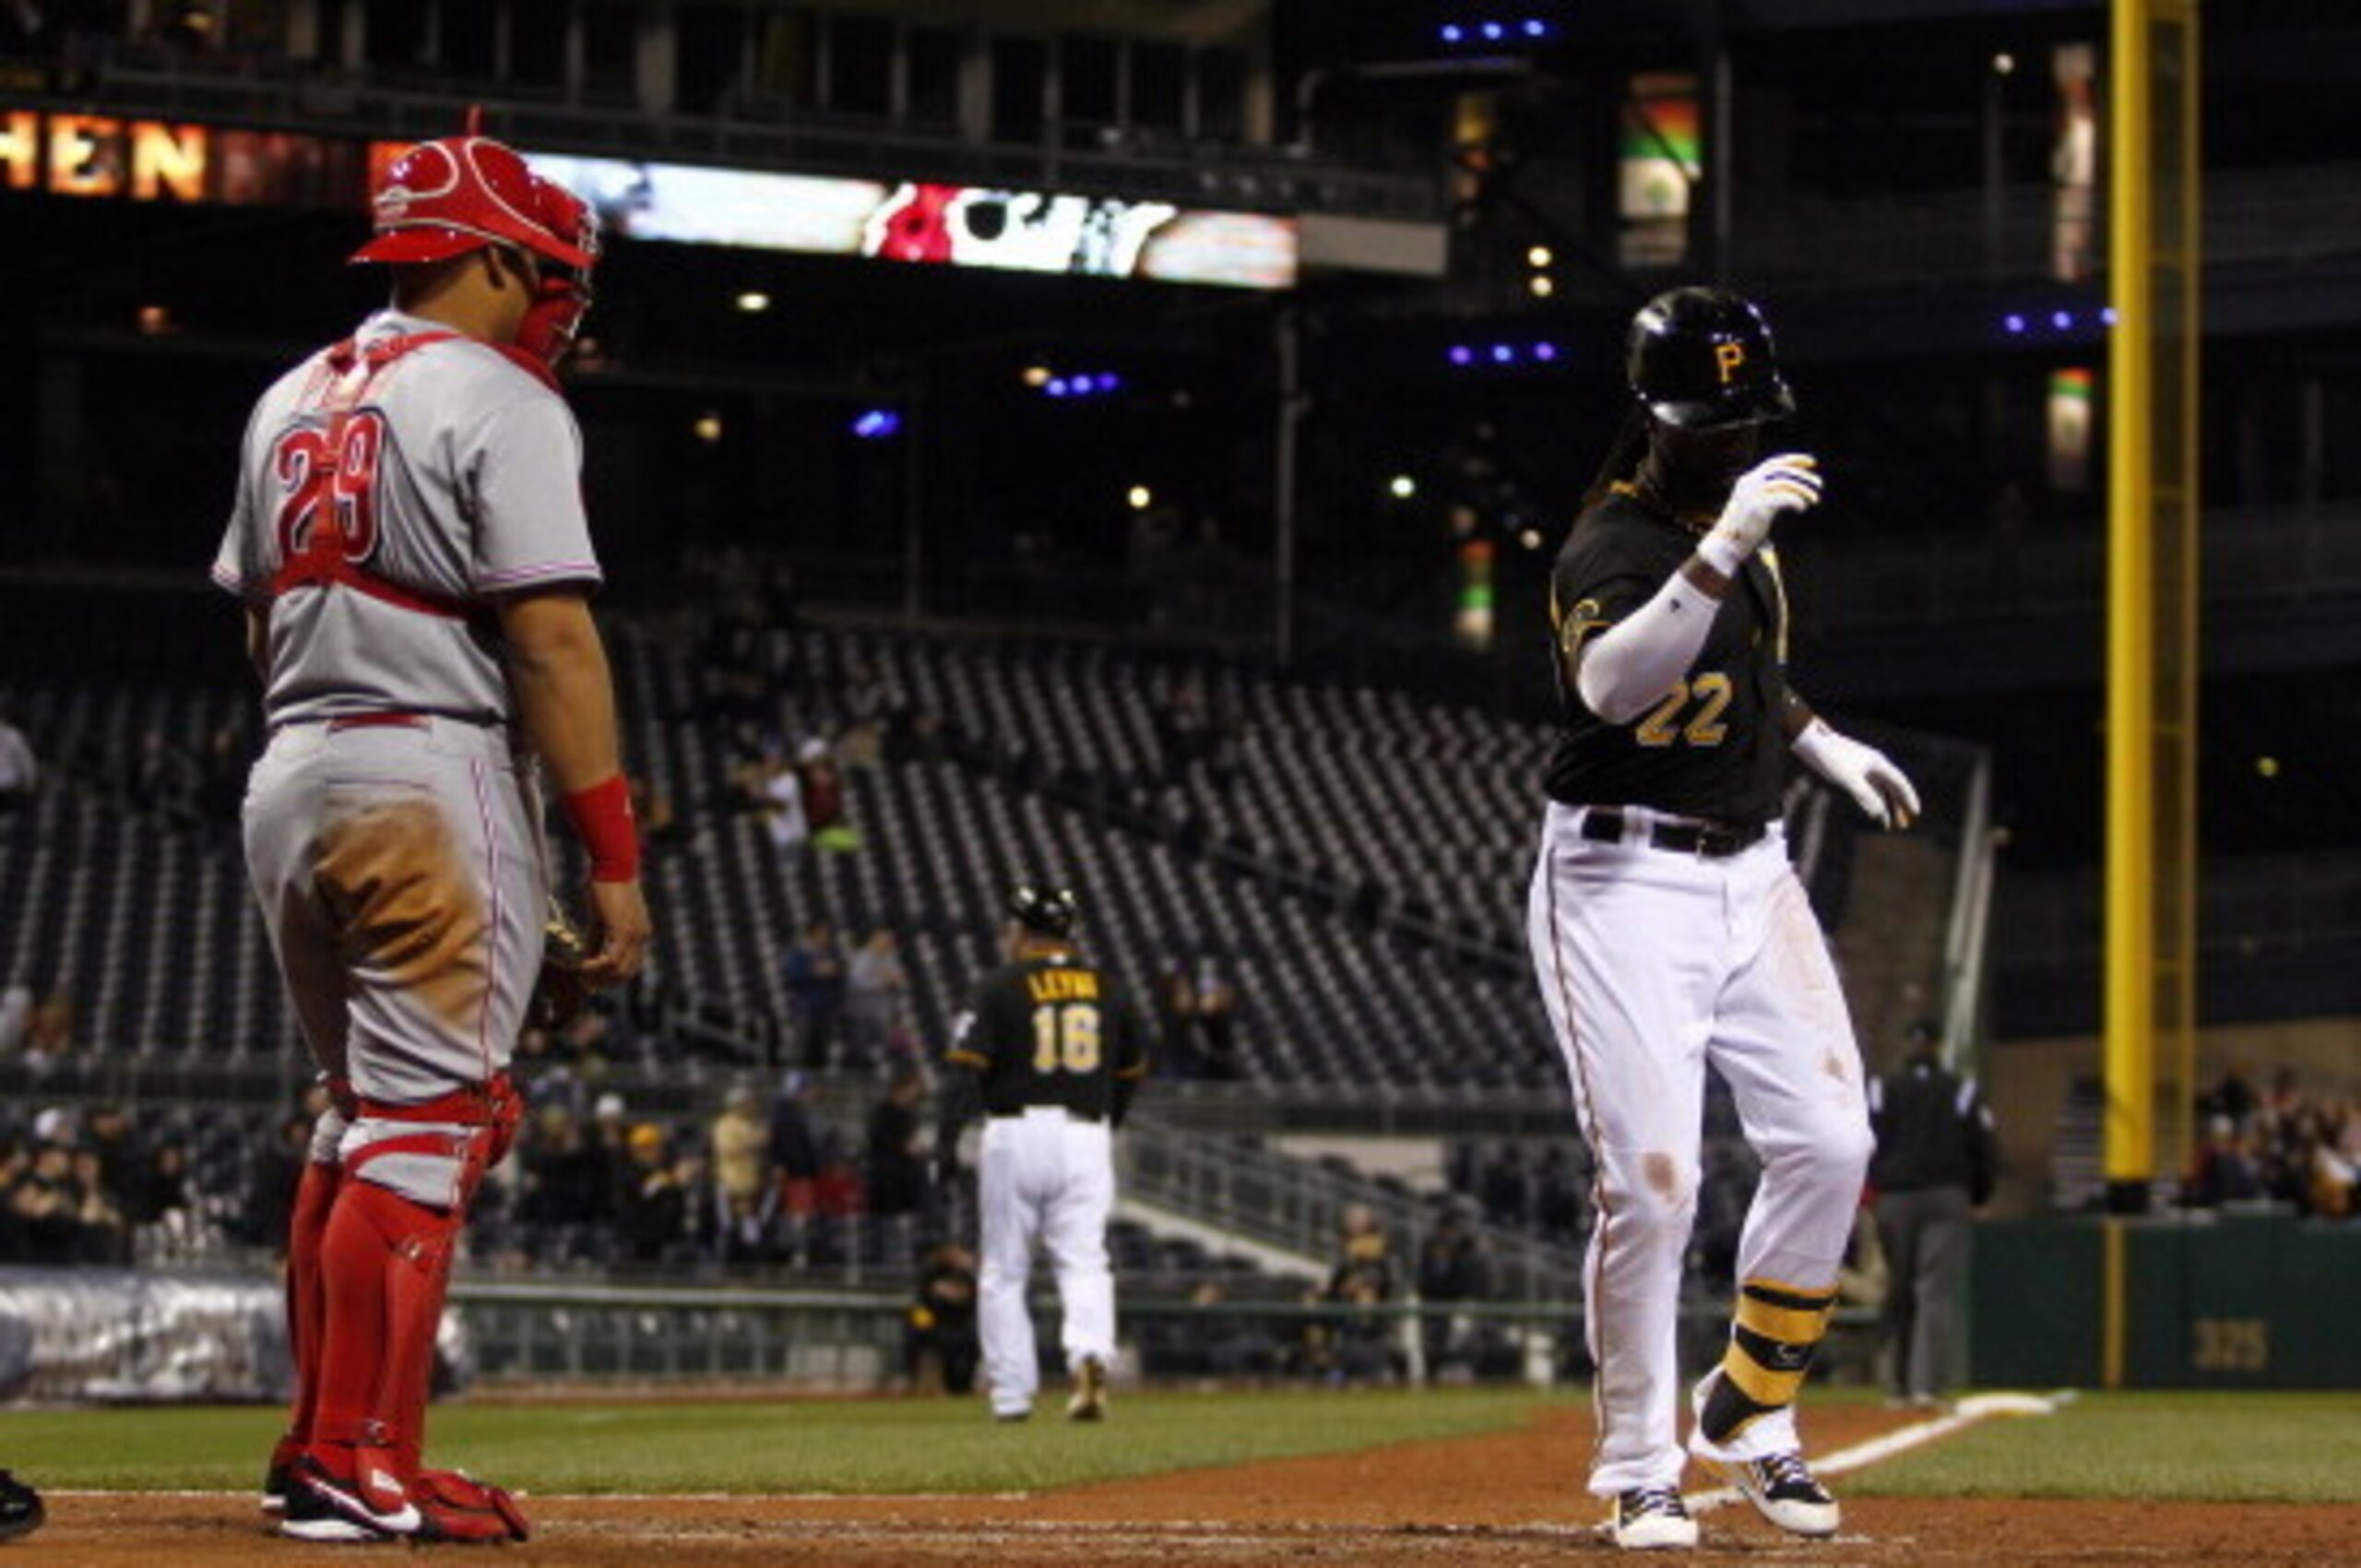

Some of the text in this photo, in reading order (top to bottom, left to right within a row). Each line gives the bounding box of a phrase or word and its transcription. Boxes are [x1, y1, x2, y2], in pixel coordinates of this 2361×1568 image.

[0, 110, 207, 201] HEN
[1715, 342, 1743, 384] P
[273, 409, 385, 564] 29
[1635, 671, 1732, 747] 22
[1032, 1002, 1102, 1075] 16
